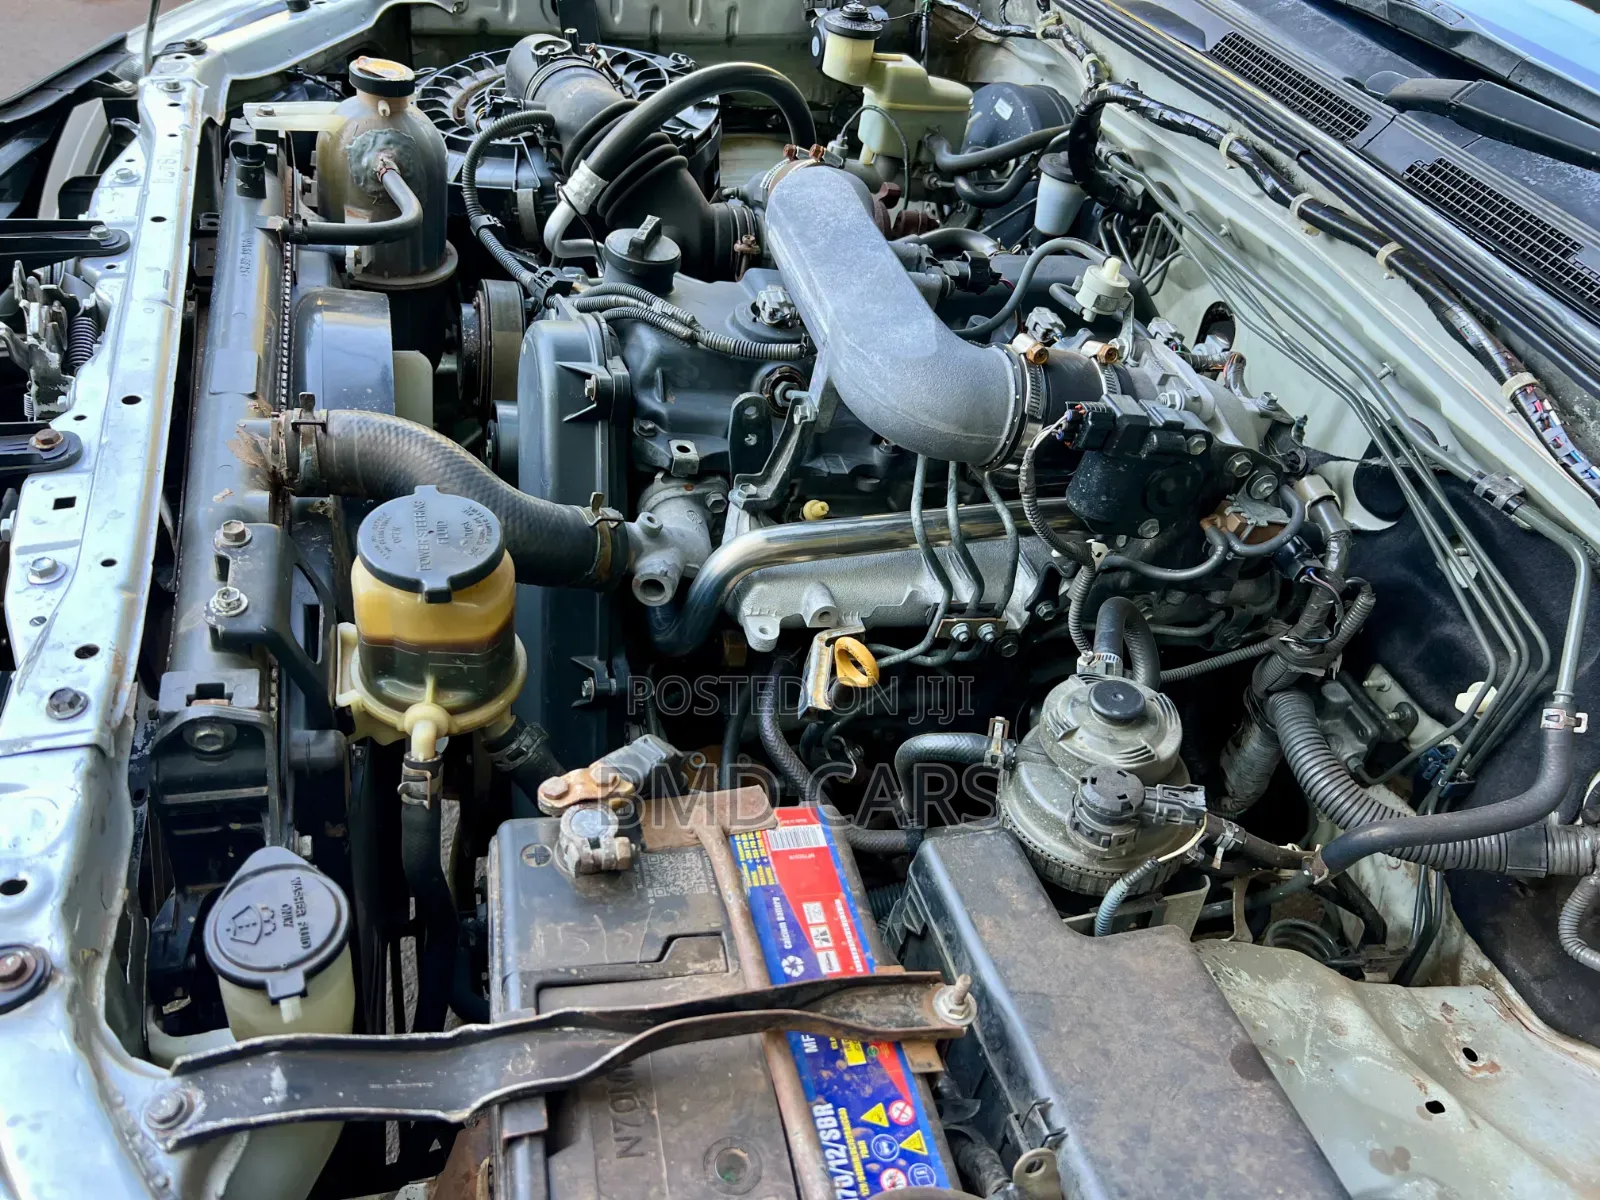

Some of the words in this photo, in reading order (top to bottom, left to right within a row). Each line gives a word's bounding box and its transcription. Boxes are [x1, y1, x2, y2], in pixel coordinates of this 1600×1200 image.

[413, 500, 429, 538] STEERING
[436, 520, 450, 545] FLUID
[416, 539, 432, 572] POWER
[291, 876, 307, 918] WASHER
[772, 896, 785, 922] Battery
[281, 903, 294, 928] ONLY
[297, 921, 311, 949] FLUID
[779, 922, 793, 950] Calcium
[801, 1034, 819, 1054] MF
[812, 1103, 860, 1200] 70/12/SBR
